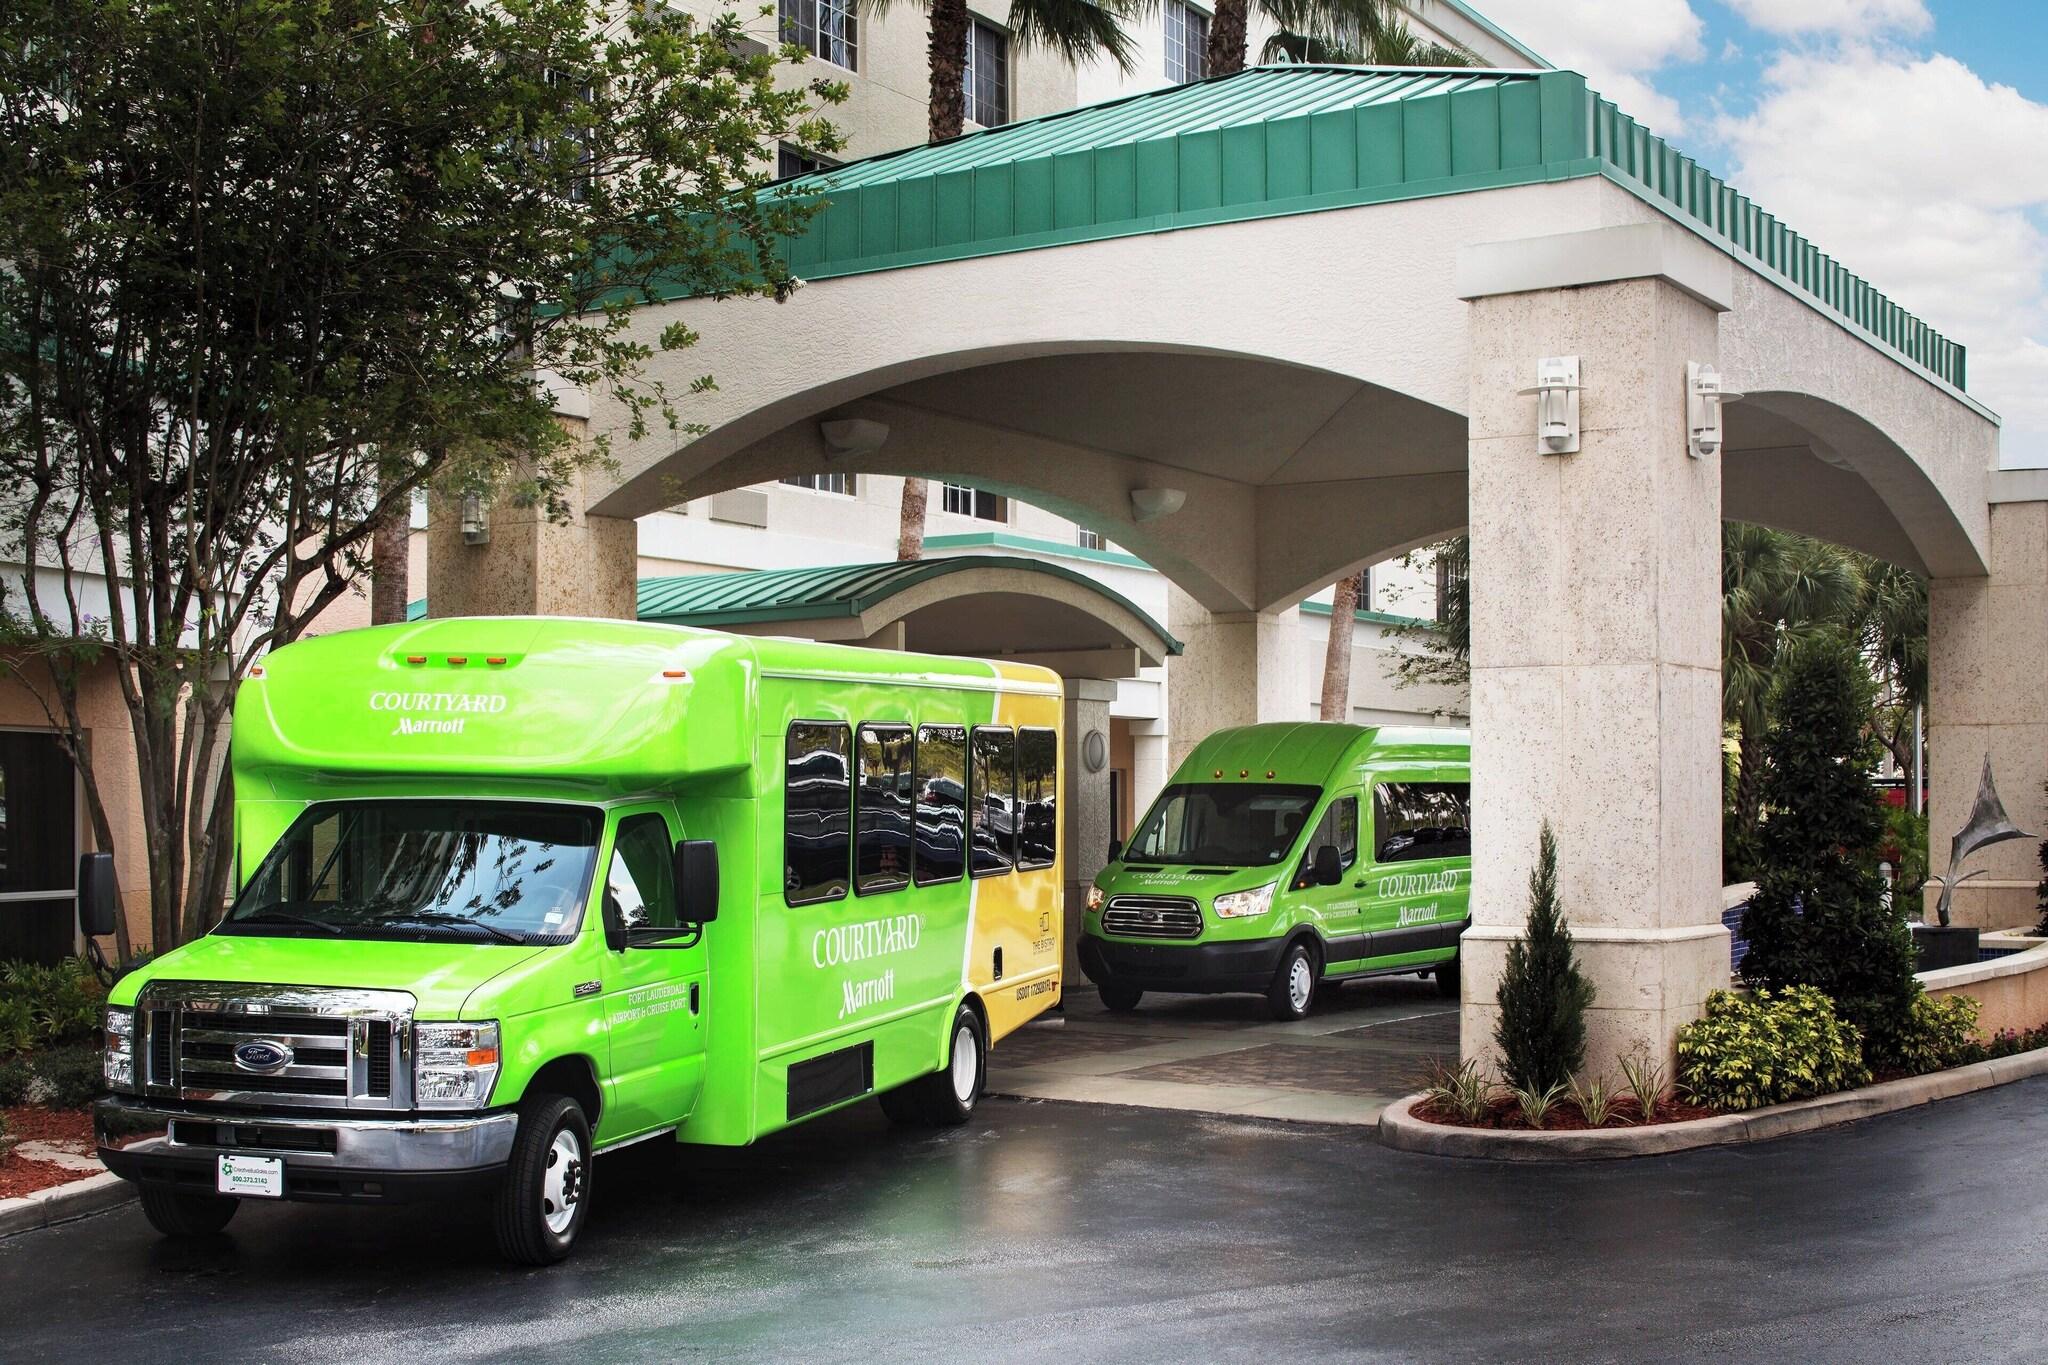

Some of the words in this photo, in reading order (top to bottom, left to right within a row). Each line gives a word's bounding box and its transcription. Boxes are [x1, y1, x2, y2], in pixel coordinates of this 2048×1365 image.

[369, 692, 507, 713] COURTYARD
[391, 717, 465, 736] Marriott
[1395, 901, 1438, 928] Marriott
[628, 991, 646, 1005] FORT
[646, 983, 687, 1001] LAUDERDALE
[838, 968, 895, 1020] Marriott
[647, 1001, 670, 1015] CRUISE
[670, 998, 687, 1010] PORT
[245, 1047, 271, 1061] Ford
